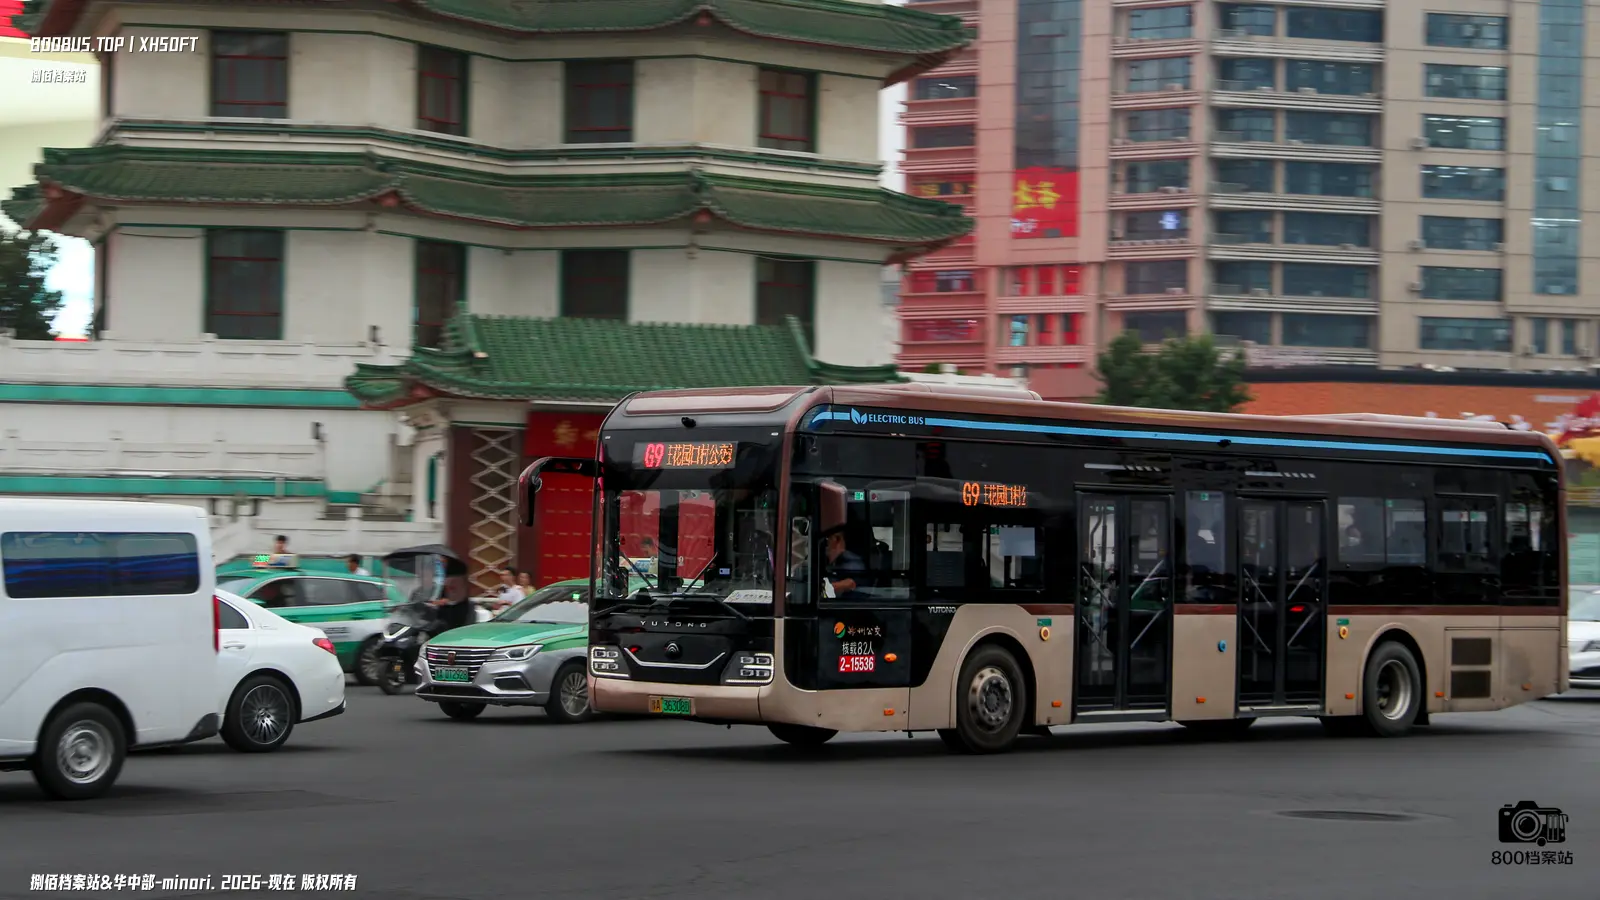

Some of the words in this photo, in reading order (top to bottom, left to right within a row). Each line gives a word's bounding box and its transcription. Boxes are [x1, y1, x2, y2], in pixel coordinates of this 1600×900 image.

[868, 413, 907, 424] ELECTRIC
[908, 416, 924, 425] BUS
[644, 443, 665, 468] G9
[962, 482, 980, 506] G9
[640, 620, 707, 628] YUTONG
[842, 641, 874, 655] 核载82人
[840, 656, 874, 671] 2-15536
